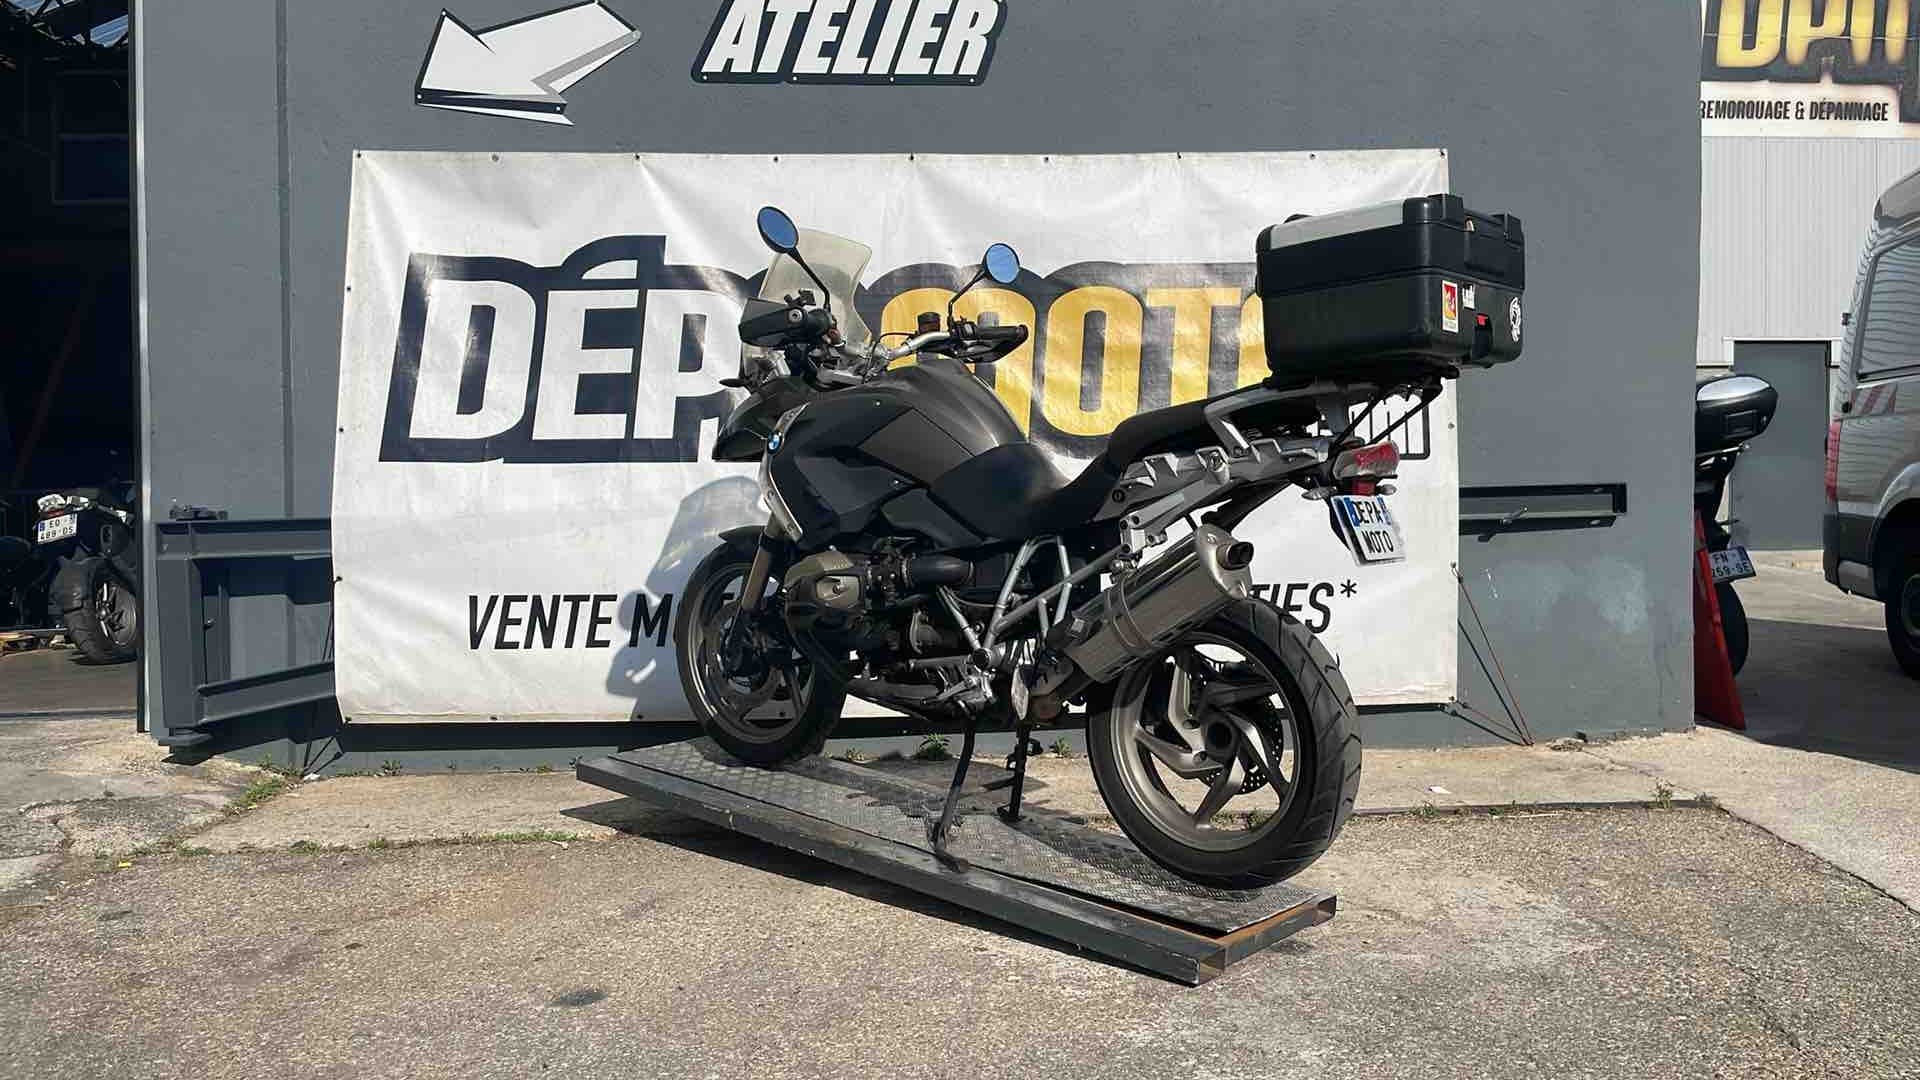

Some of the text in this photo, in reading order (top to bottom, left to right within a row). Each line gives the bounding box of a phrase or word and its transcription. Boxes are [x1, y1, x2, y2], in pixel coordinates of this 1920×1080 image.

[700, 0, 999, 75] ATELIER
[1795, 101, 1804, 120] &
[1809, 97, 1889, 122] DÉPANNAGE
[1361, 530, 1394, 553] MOTO
[467, 593, 618, 650] VENTE
